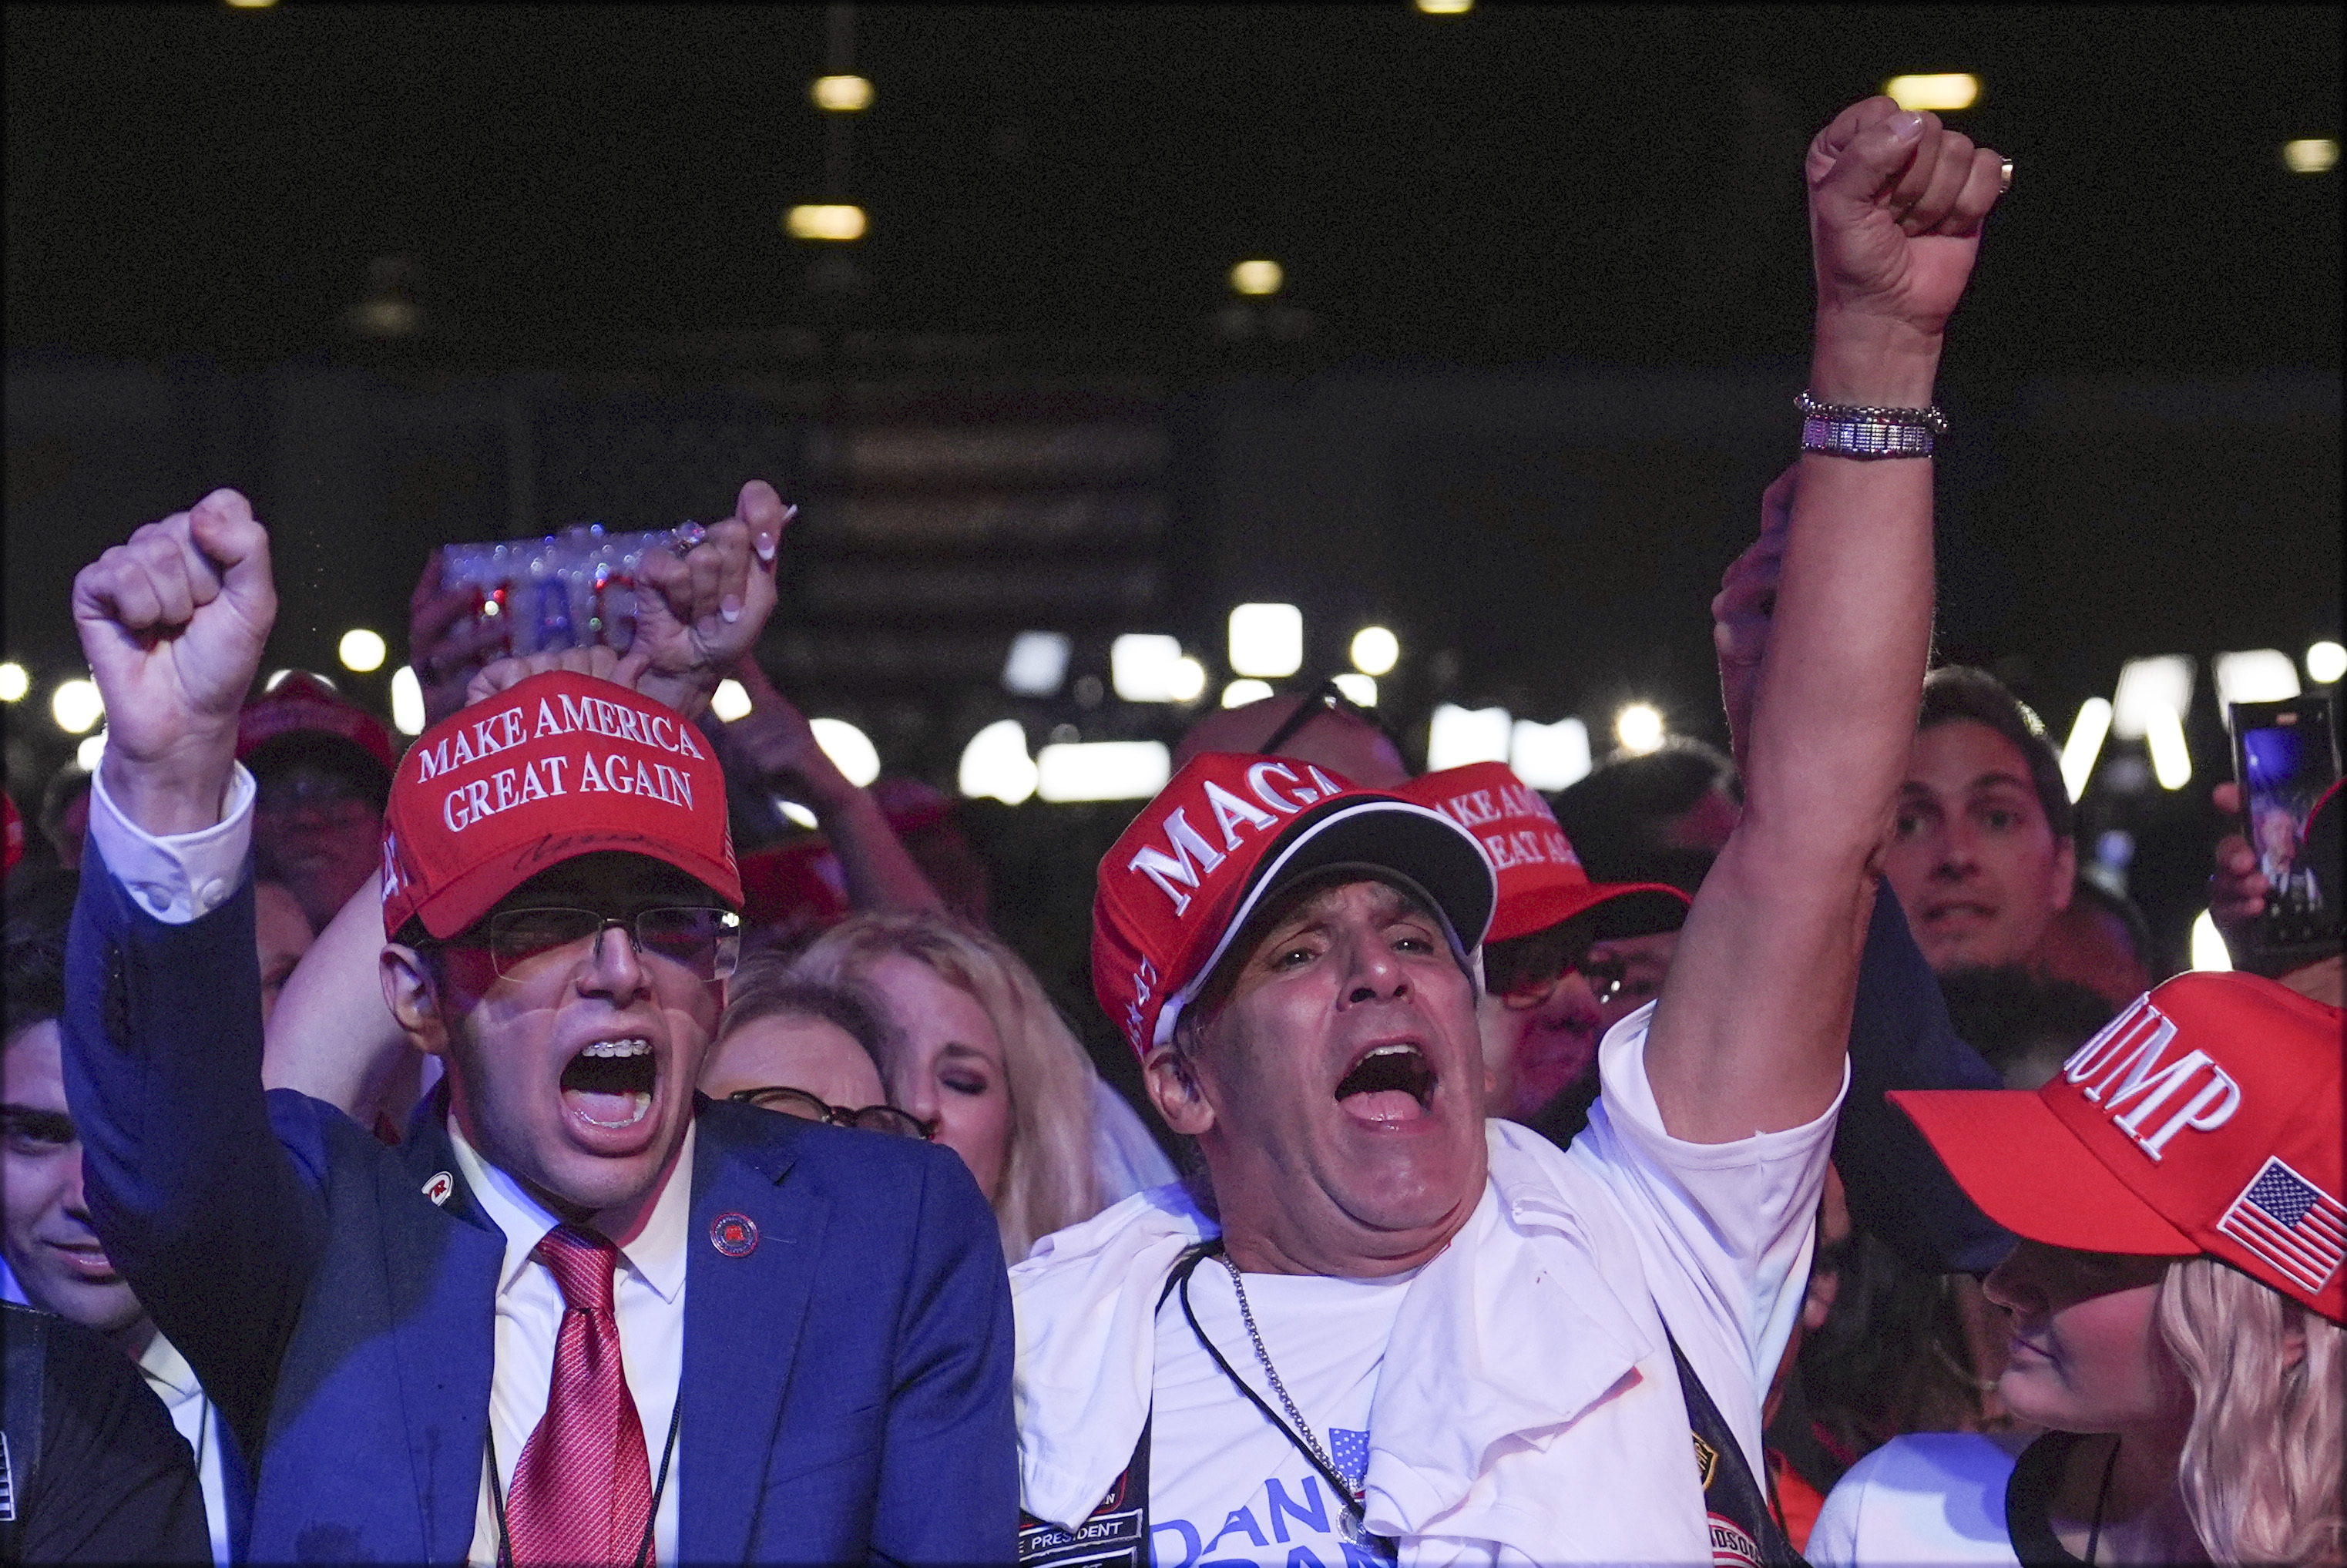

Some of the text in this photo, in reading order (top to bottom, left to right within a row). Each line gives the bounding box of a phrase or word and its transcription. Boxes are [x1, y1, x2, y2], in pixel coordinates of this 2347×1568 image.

[417, 693, 706, 784] MAKE AMERICA
[443, 750, 694, 833] GREAT AGAIN
[2063, 991, 2241, 1161] UMP
[1031, 1521, 1124, 1550] PRESDENT
